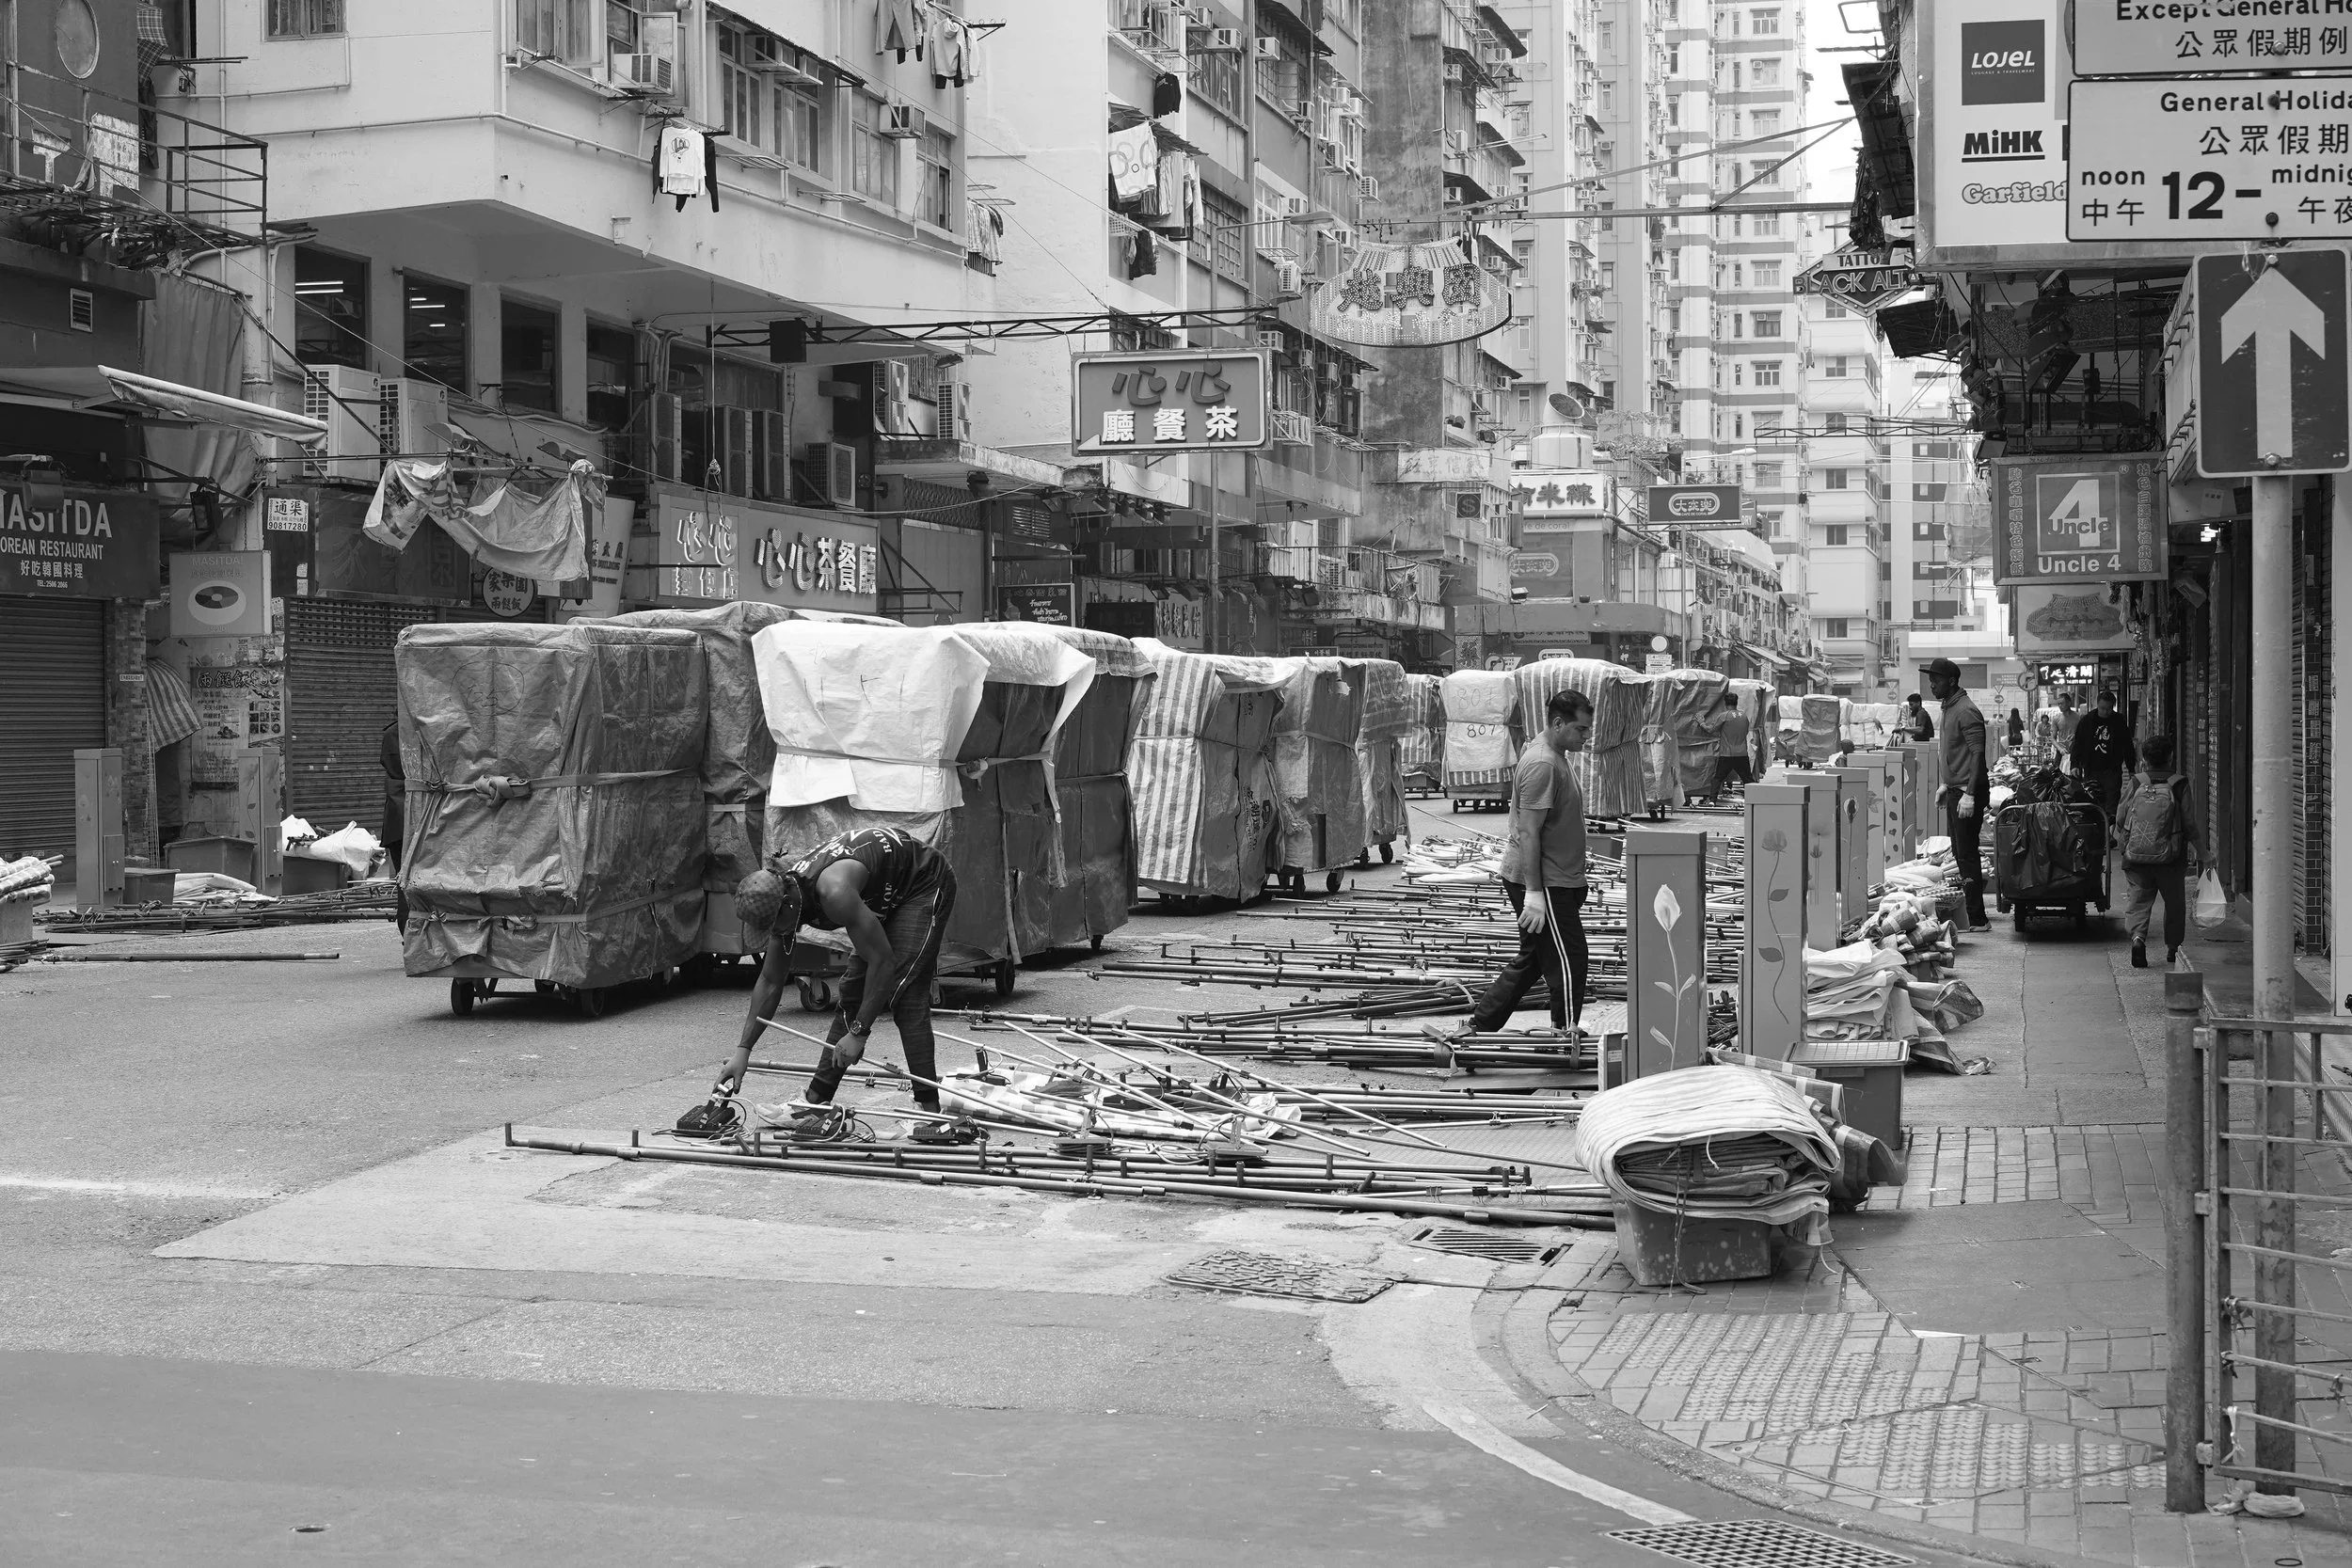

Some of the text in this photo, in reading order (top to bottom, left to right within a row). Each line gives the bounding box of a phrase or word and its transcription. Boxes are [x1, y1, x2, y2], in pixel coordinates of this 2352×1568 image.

[2117, 0, 2211, 23] Except
[2175, 26, 2347, 58] 公眾假期例
[2160, 92, 2264, 112] General
[2199, 124, 2349, 156] 公眾假期
[2081, 170, 2145, 185] noon
[1962, 181, 2068, 204] Garfield
[2082, 198, 2145, 227] 中午
[1793, 271, 1866, 295] BLACK
[1112, 360, 1231, 406] 心心
[274, 500, 303, 516] 通渠
[268, 522, 307, 531] 90817280
[2048, 517, 2112, 535] Uncle
[40, 540, 103, 560] RESTAURANT
[21, 560, 84, 578] 好吃韓國料理
[754, 528, 877, 594] 心心茶餐廳
[2038, 554, 2122, 574] Uncle 4
[1467, 723, 1496, 738] 807
